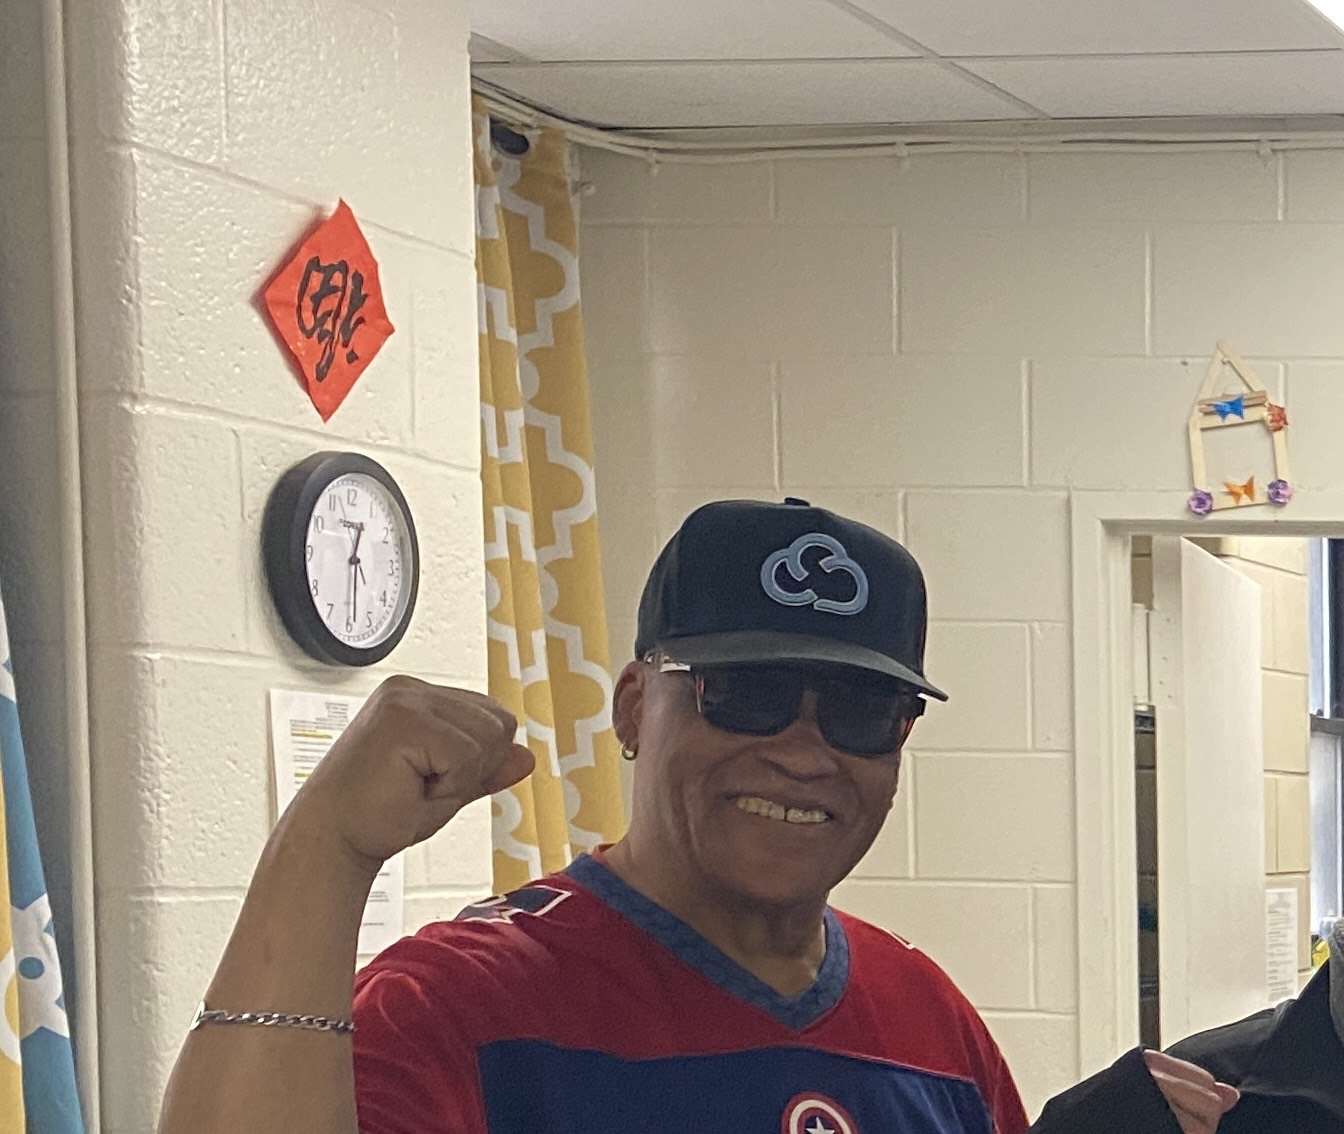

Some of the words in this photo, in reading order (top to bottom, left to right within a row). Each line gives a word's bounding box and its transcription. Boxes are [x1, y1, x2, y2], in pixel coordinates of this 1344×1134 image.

[328, 493, 337, 511] 11
[346, 488, 358, 507] 12
[313, 515, 324, 533] 10
[382, 526, 389, 544] 2
[306, 545, 314, 561] 9
[387, 559, 394, 576] 3
[312, 578, 319, 596] 8
[379, 589, 387, 607] 4
[326, 603, 334, 621] 7
[365, 611, 372, 628] 5
[345, 615, 353, 633] 6
